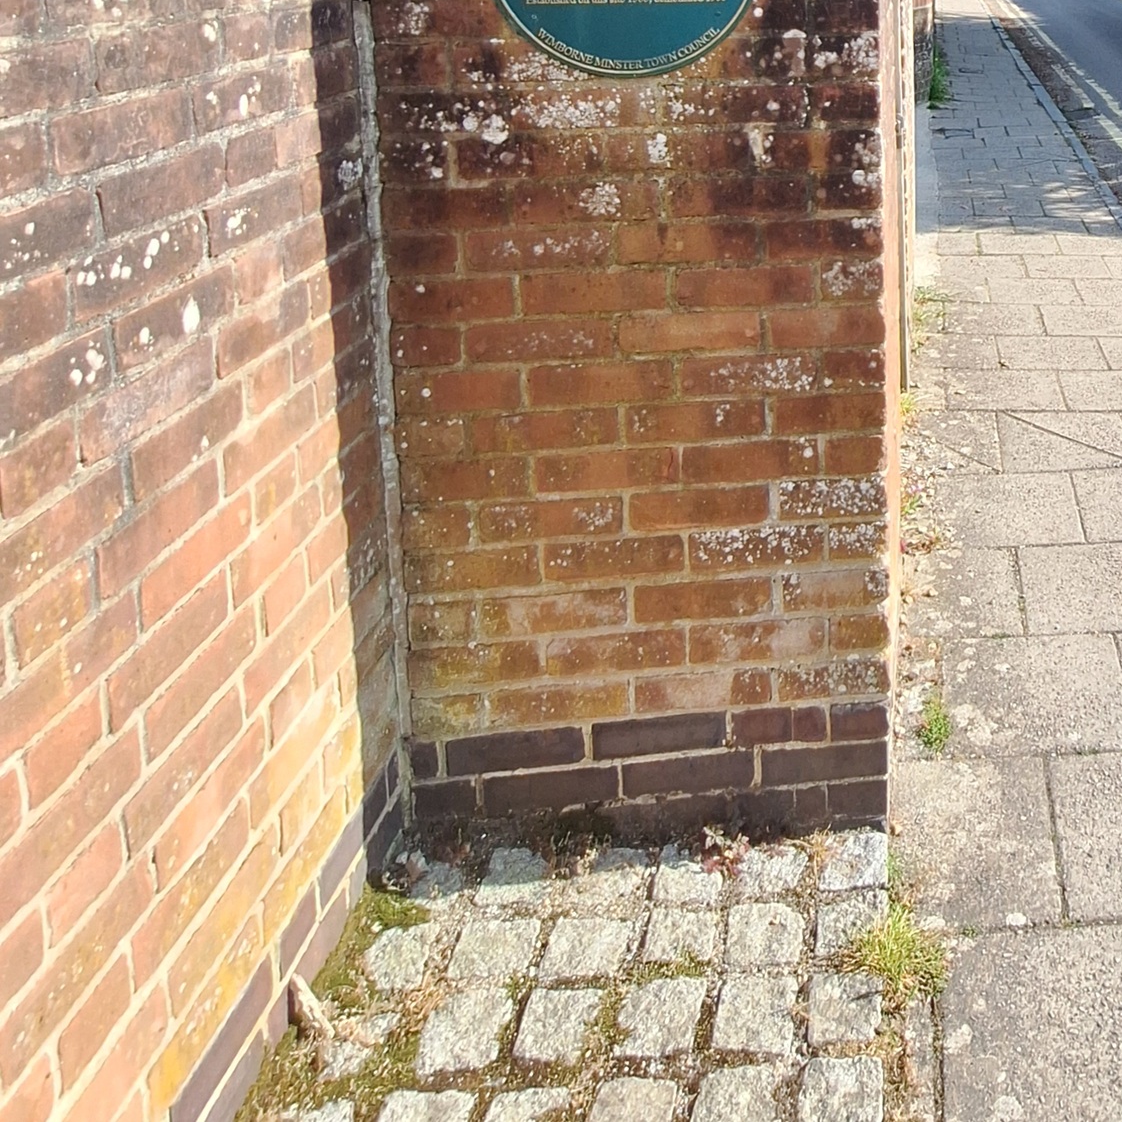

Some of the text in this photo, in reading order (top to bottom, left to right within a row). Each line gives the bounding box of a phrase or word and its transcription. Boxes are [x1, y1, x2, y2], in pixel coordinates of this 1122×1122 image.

[537, 27, 721, 69] WIMBORNE MINSTER TOWN COUNCIL
